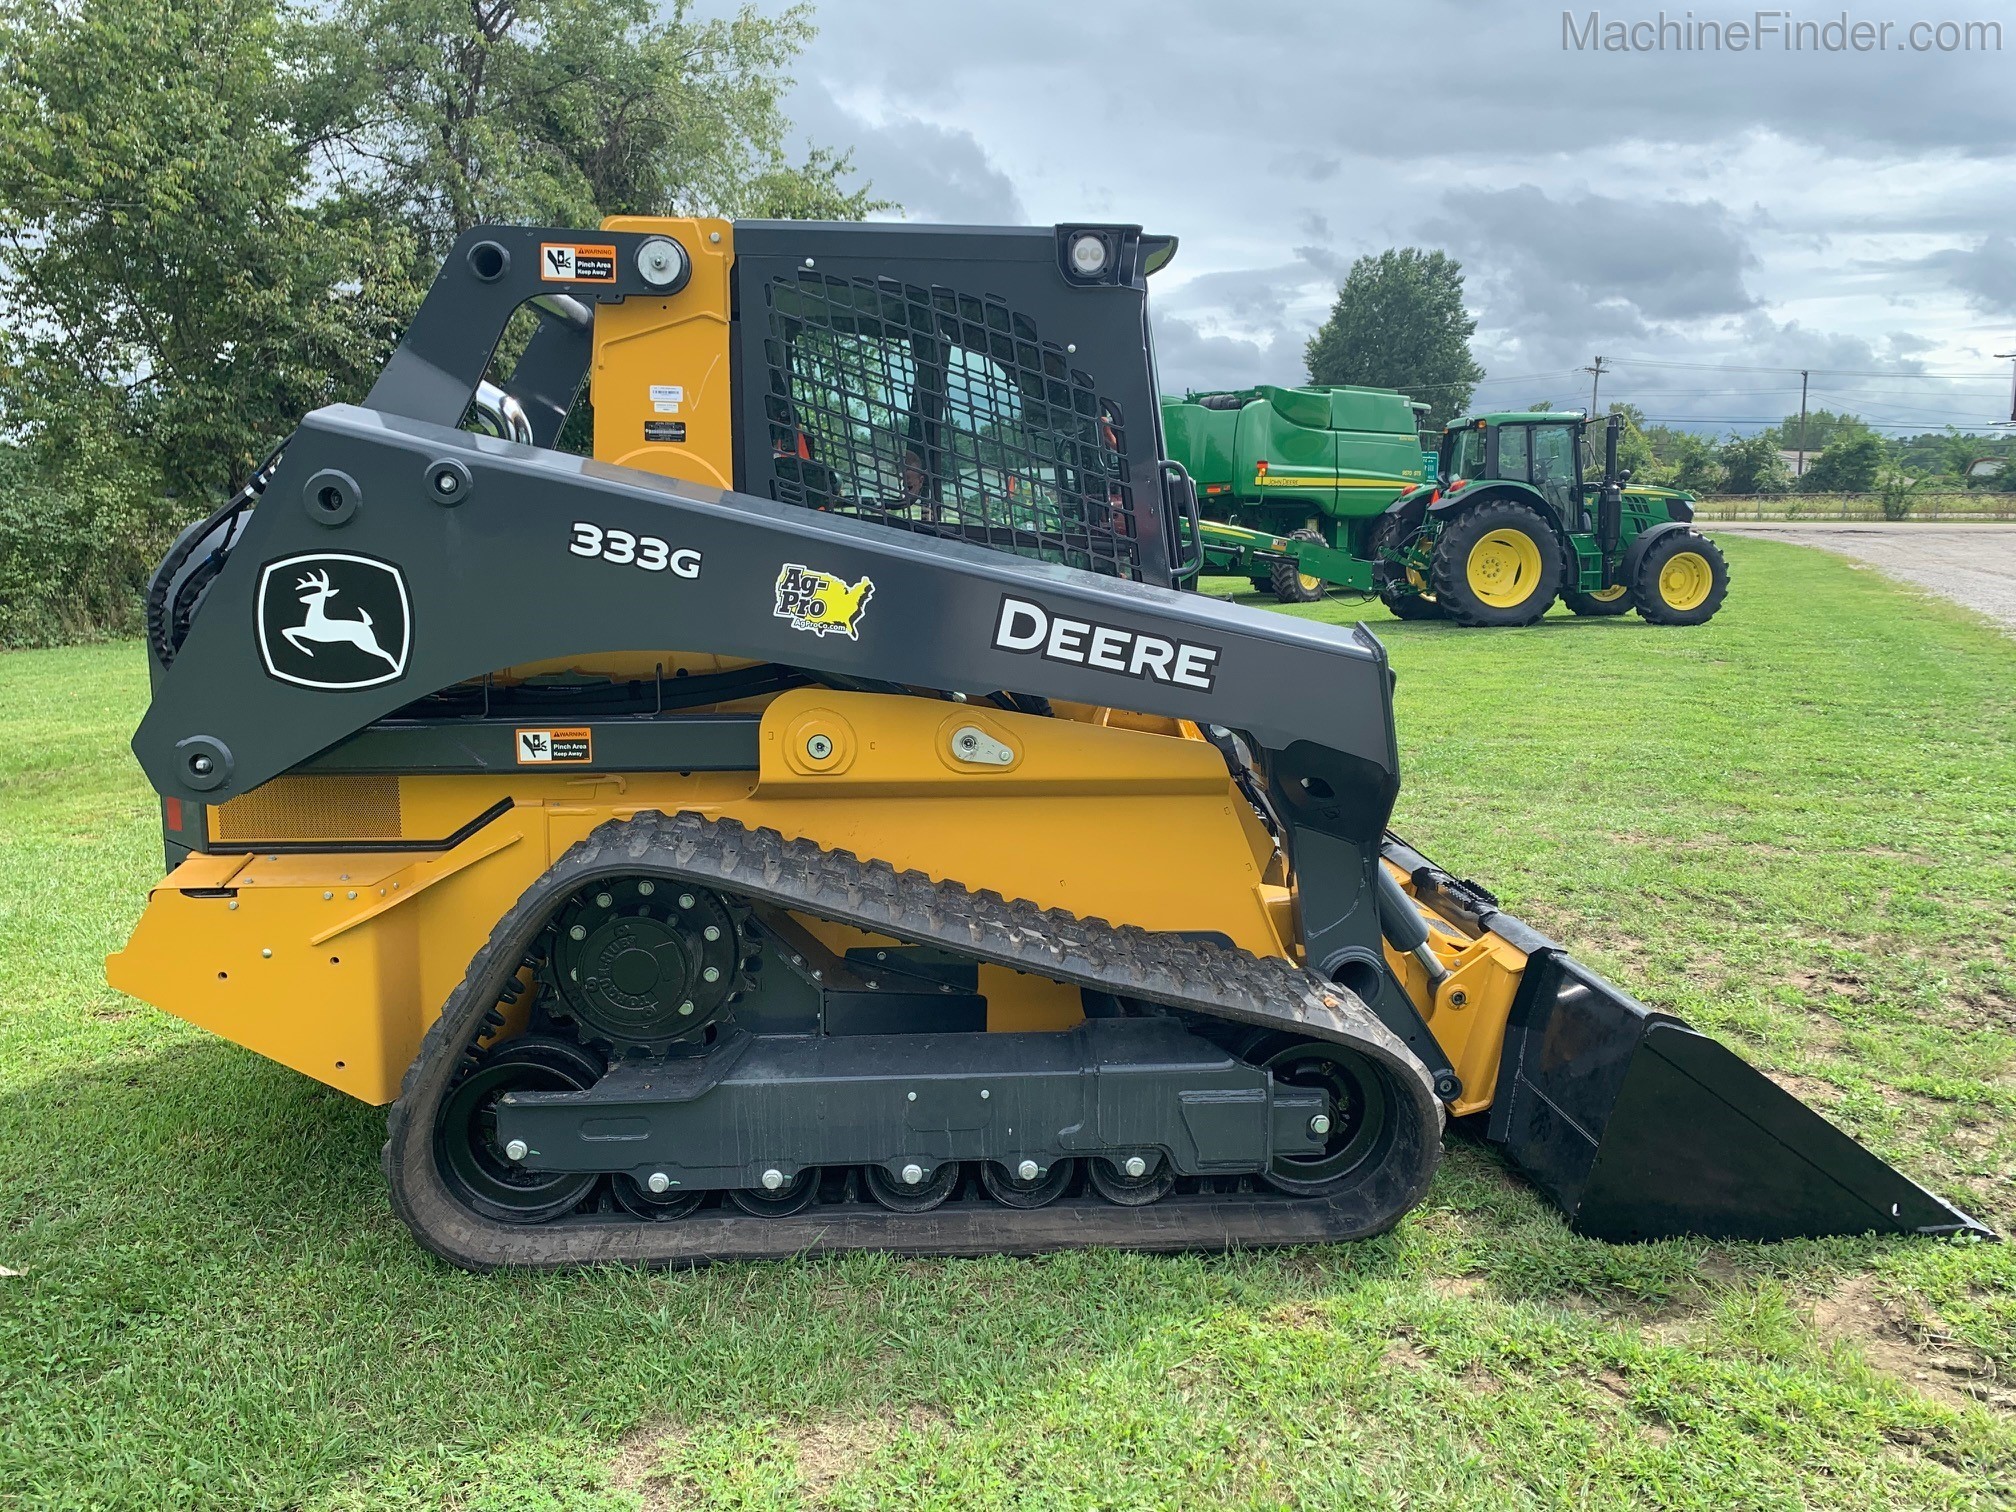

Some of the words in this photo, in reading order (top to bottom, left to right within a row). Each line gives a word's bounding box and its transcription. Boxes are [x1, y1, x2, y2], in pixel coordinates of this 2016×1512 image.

[584, 248, 612, 256] WARNING
[596, 261, 612, 269] Area
[592, 269, 607, 277] Away
[570, 522, 702, 579] 333G
[779, 591, 827, 617] Pro
[794, 618, 847, 632] AgProCo.com
[995, 597, 1218, 689] DEERE
